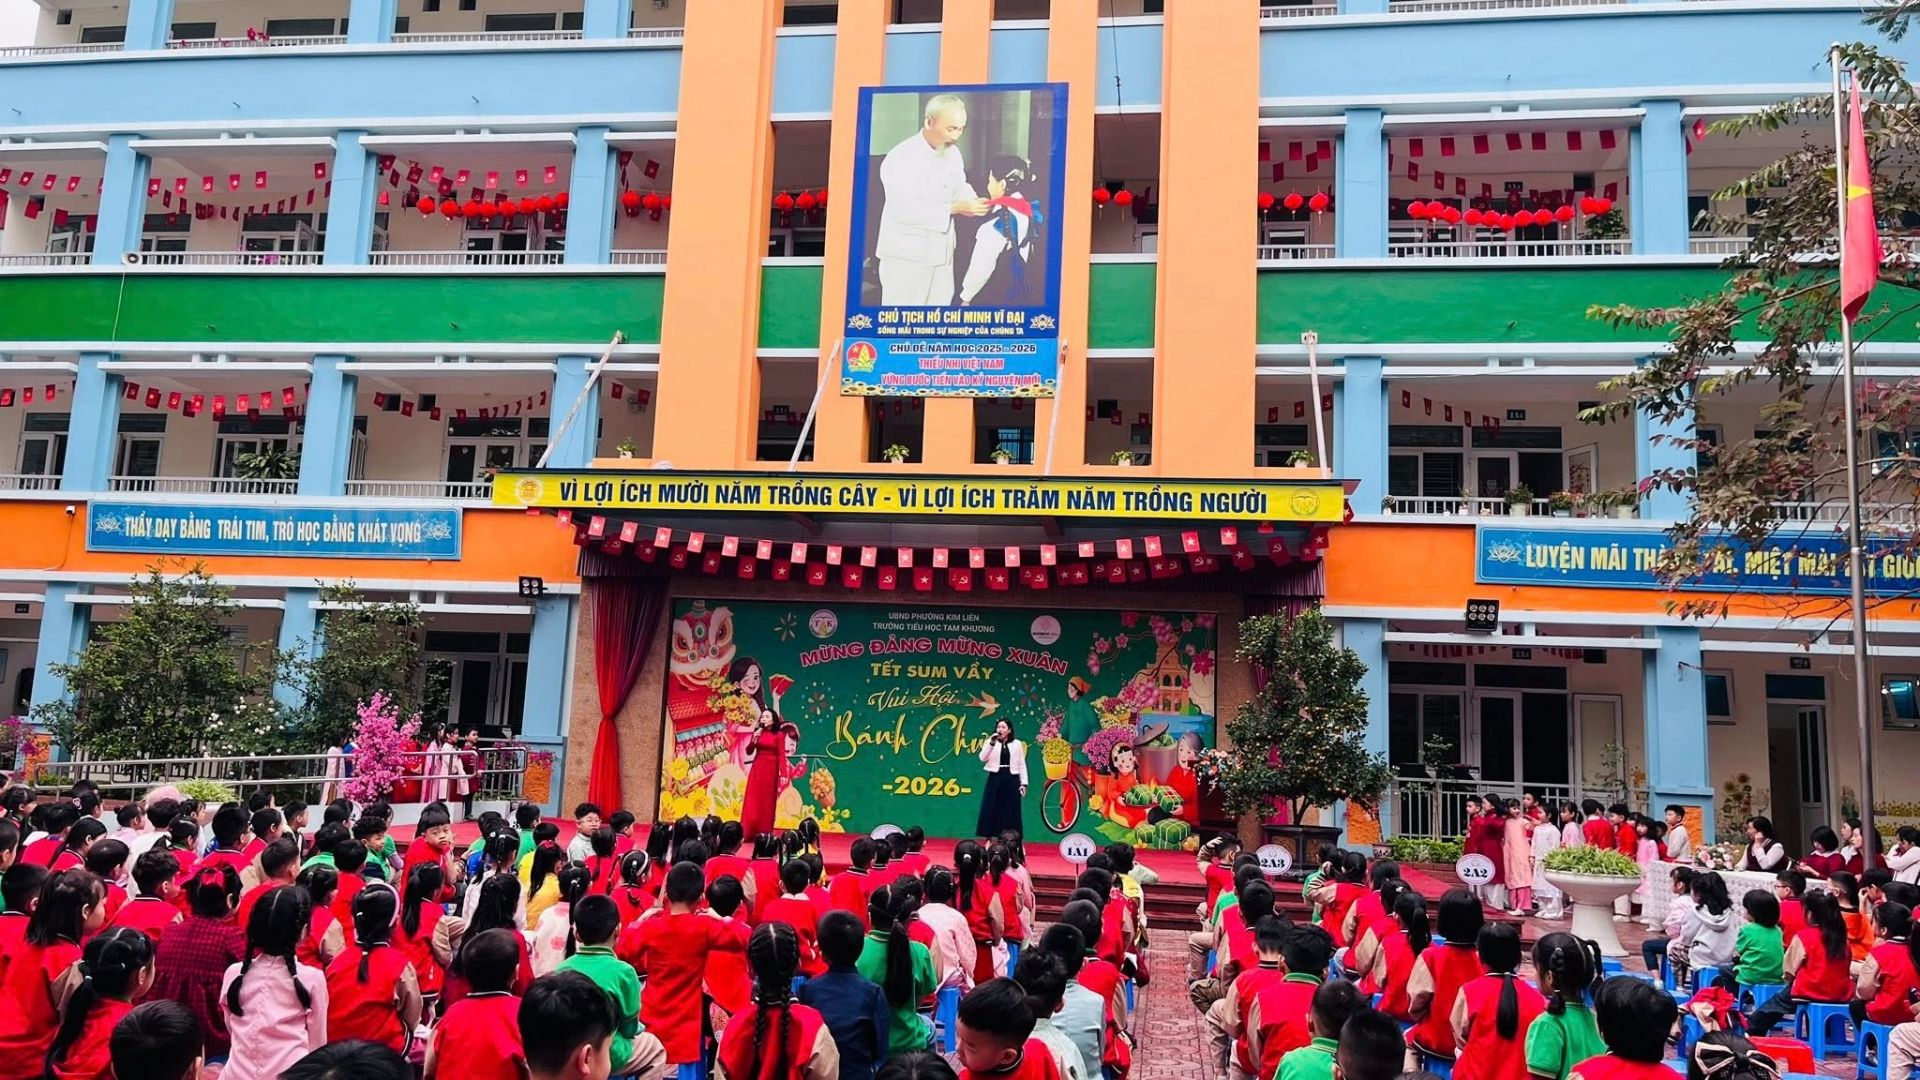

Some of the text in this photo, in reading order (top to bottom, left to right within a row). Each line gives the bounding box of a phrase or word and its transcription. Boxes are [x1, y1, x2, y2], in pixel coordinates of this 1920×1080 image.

[878, 308, 899, 323] CHỦ
[902, 311, 924, 325] TỊCH
[943, 309, 961, 323] CHÍ
[963, 310, 991, 323] MINH
[994, 309, 1004, 323] VĨ
[1006, 310, 1025, 326] ĐẠI
[1015, 327, 1024, 335] TA
[954, 344, 974, 353] HỌC
[976, 344, 1002, 353] 2025
[1011, 344, 1036, 353] 2026
[945, 358, 961, 369] NHI
[983, 358, 1004, 369] NAM
[560, 481, 577, 501] VÌ
[584, 481, 612, 506] LỢI
[620, 479, 652, 502] ÍCH
[658, 480, 708, 503] MƯỜI
[716, 482, 761, 505] NĂM
[768, 480, 831, 506] TRỒNG
[838, 482, 878, 506] CÂY
[898, 487, 917, 507] VÌ
[924, 487, 954, 512] LỢI
[961, 484, 995, 508] ÍCH
[1002, 485, 1060, 510] TRĂM
[1067, 486, 1116, 511] NĂM
[1122, 485, 1193, 513] TRỒNG
[1200, 489, 1267, 514] NGƯỜI
[155, 517, 177, 542] DẠY
[180, 511, 211, 539] BẰNG
[217, 515, 242, 540] TRÁI
[246, 520, 269, 543] TIM,
[273, 516, 294, 541] TRÒ
[297, 521, 320, 546] HỌC
[323, 514, 354, 542] BẰNG
[358, 518, 387, 543] KHÁT
[390, 522, 421, 547] VỌNG
[1526, 541, 1585, 574] LUYỆN
[1590, 543, 1627, 571] MÃI
[1744, 547, 1794, 580] MIỆT
[888, 612, 910, 620] UBND
[946, 613, 961, 621] KIM
[873, 621, 905, 631] TRƯỜNG
[925, 623, 941, 632] HỌC
[943, 624, 960, 632] TAM
[800, 634, 1068, 676] MỪNG ĐẢNG MỪNG XUÂN
[871, 659, 902, 677] TẾT
[907, 665, 947, 678] SUM
[867, 687, 911, 712] Vui
[826, 710, 912, 761] Bánh
[1067, 847, 1088, 857] 1A1
[1261, 858, 1285, 868] 2A3
[1463, 867, 1488, 878] 2A2
